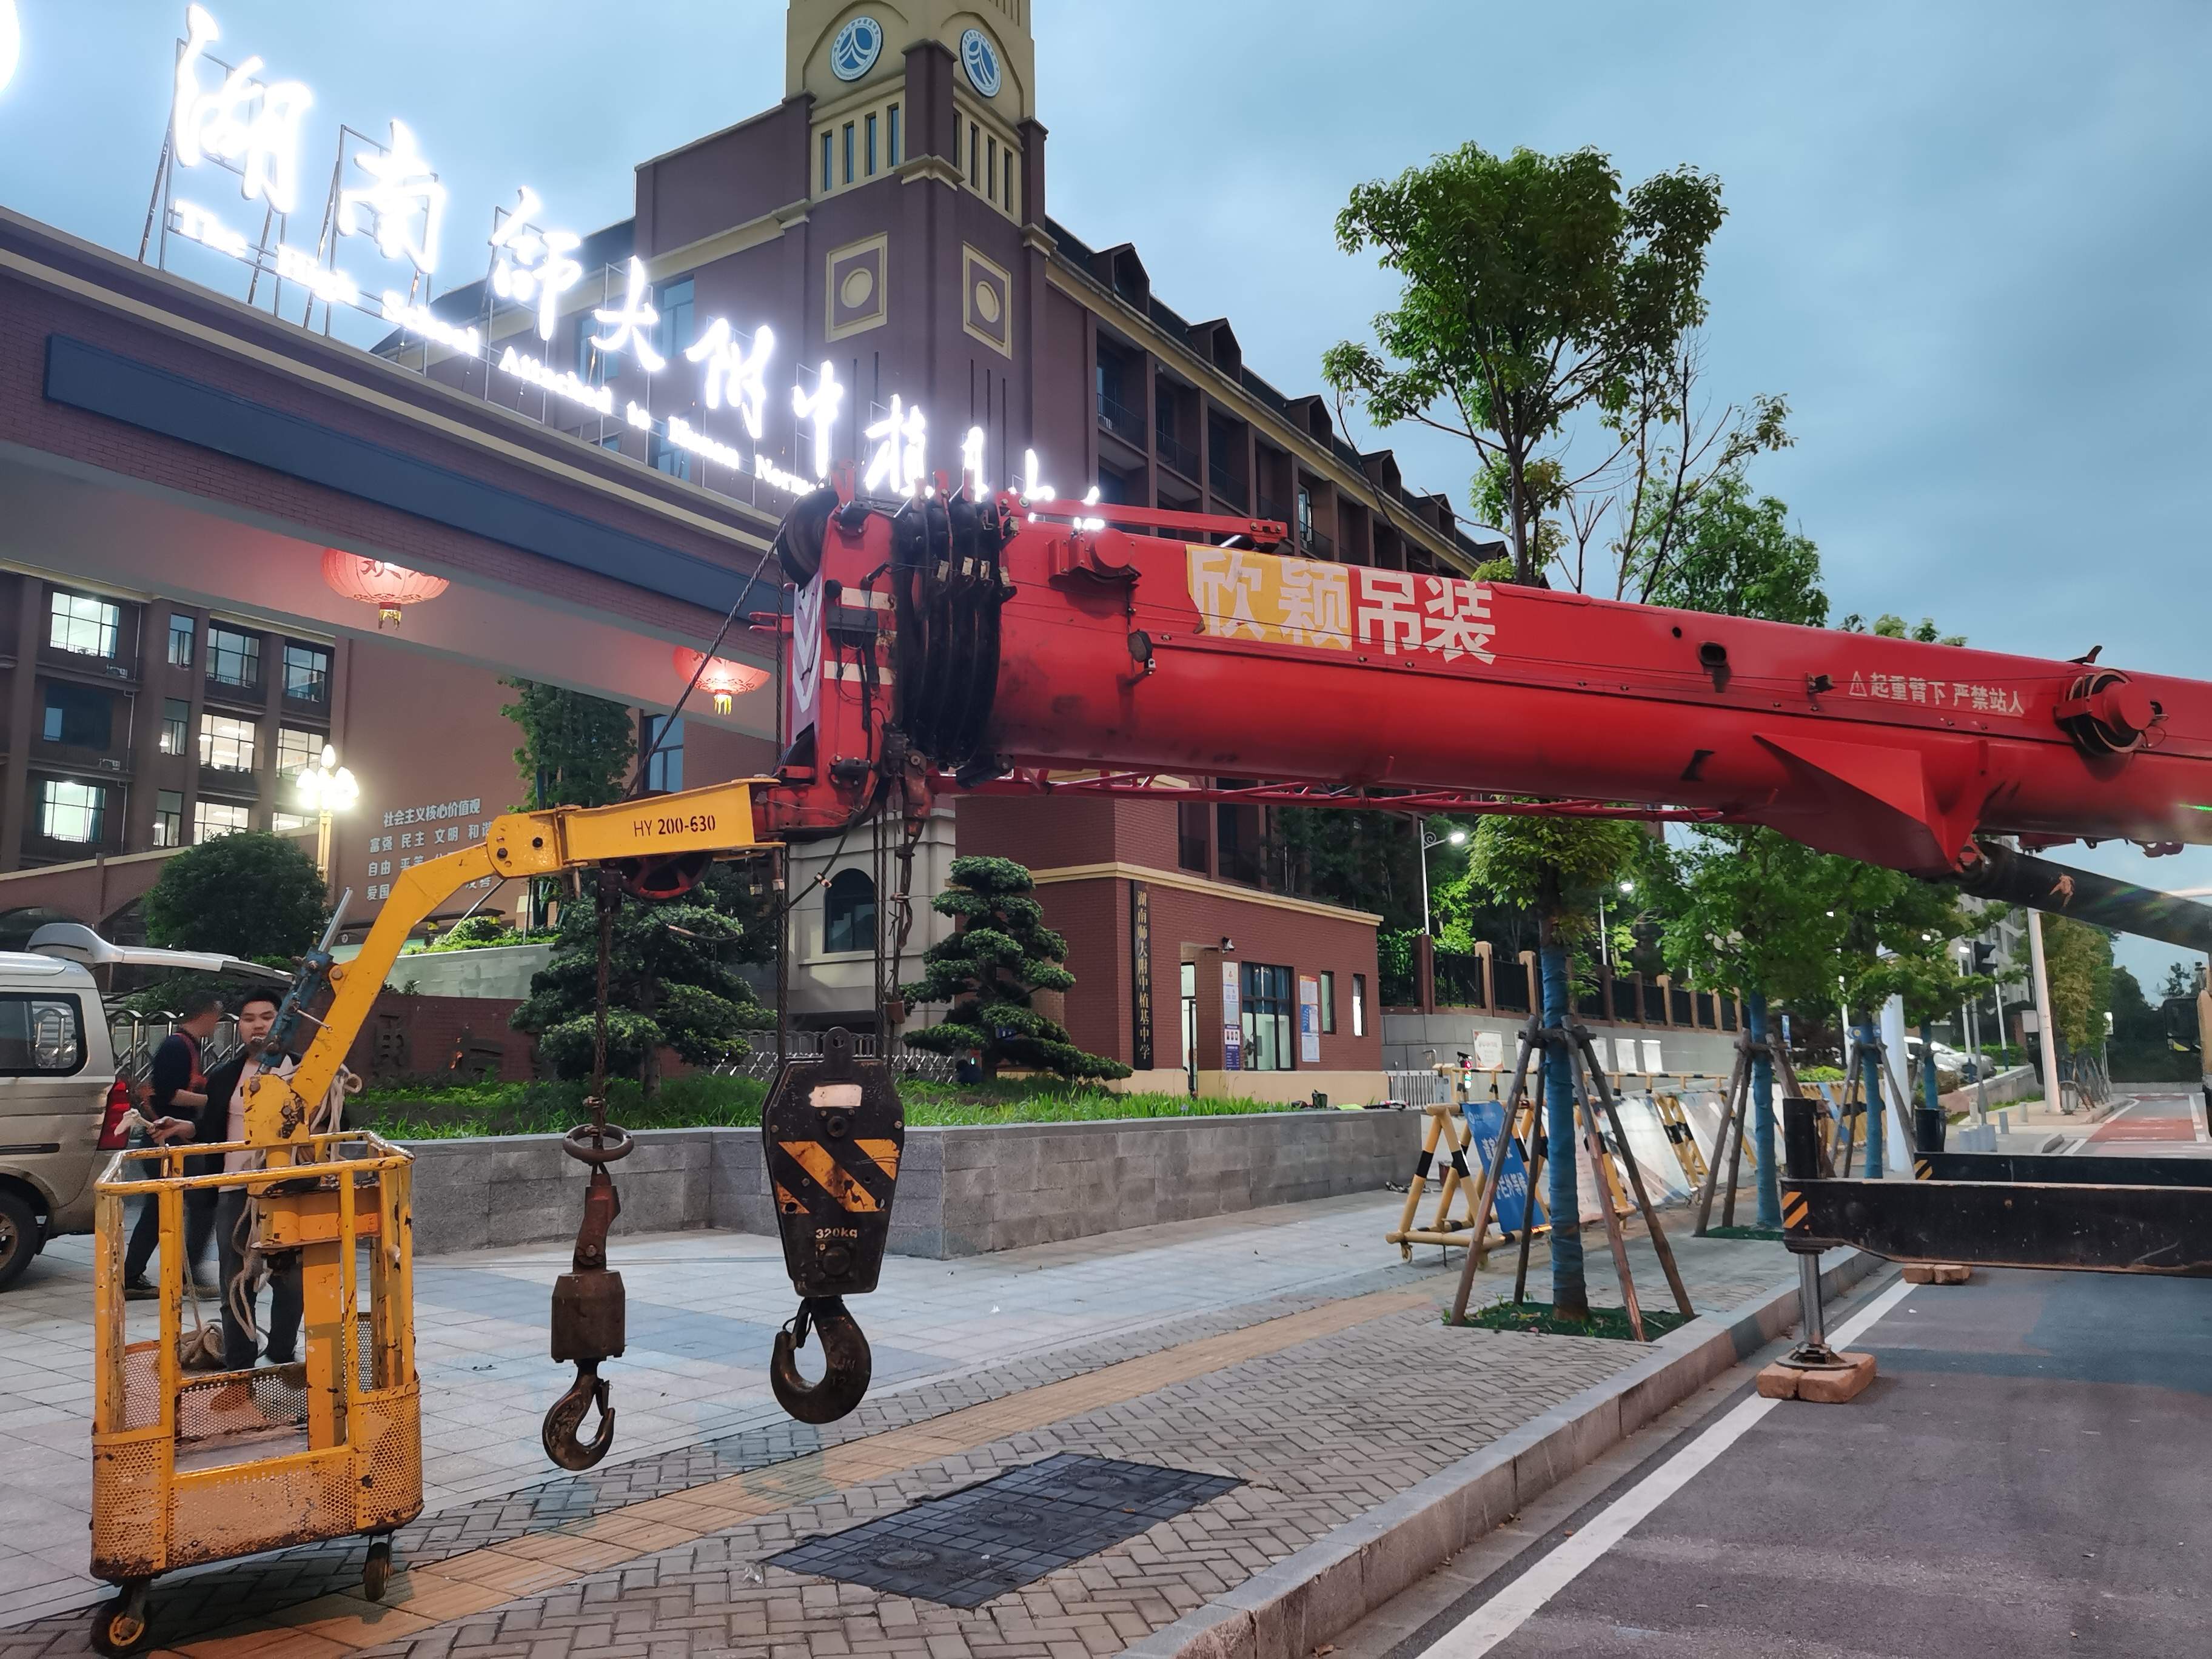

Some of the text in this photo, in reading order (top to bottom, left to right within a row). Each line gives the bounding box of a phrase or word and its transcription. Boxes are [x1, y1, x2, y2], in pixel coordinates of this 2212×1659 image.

[1191, 549, 1496, 665] 欣颖吊装
[1869, 672, 2025, 714] 起重臂下 严禁站人
[384, 798, 481, 828] 社会主义核心价值观
[634, 815, 716, 837] HY 200-630
[370, 836, 393, 853] 富强
[401, 831, 424, 849] 民主
[435, 826, 458, 844] 文明
[369, 860, 390, 877] 自由
[367, 883, 390, 901] 爱国
[1138, 891, 1150, 1060] 湖南师大附中植基中学
